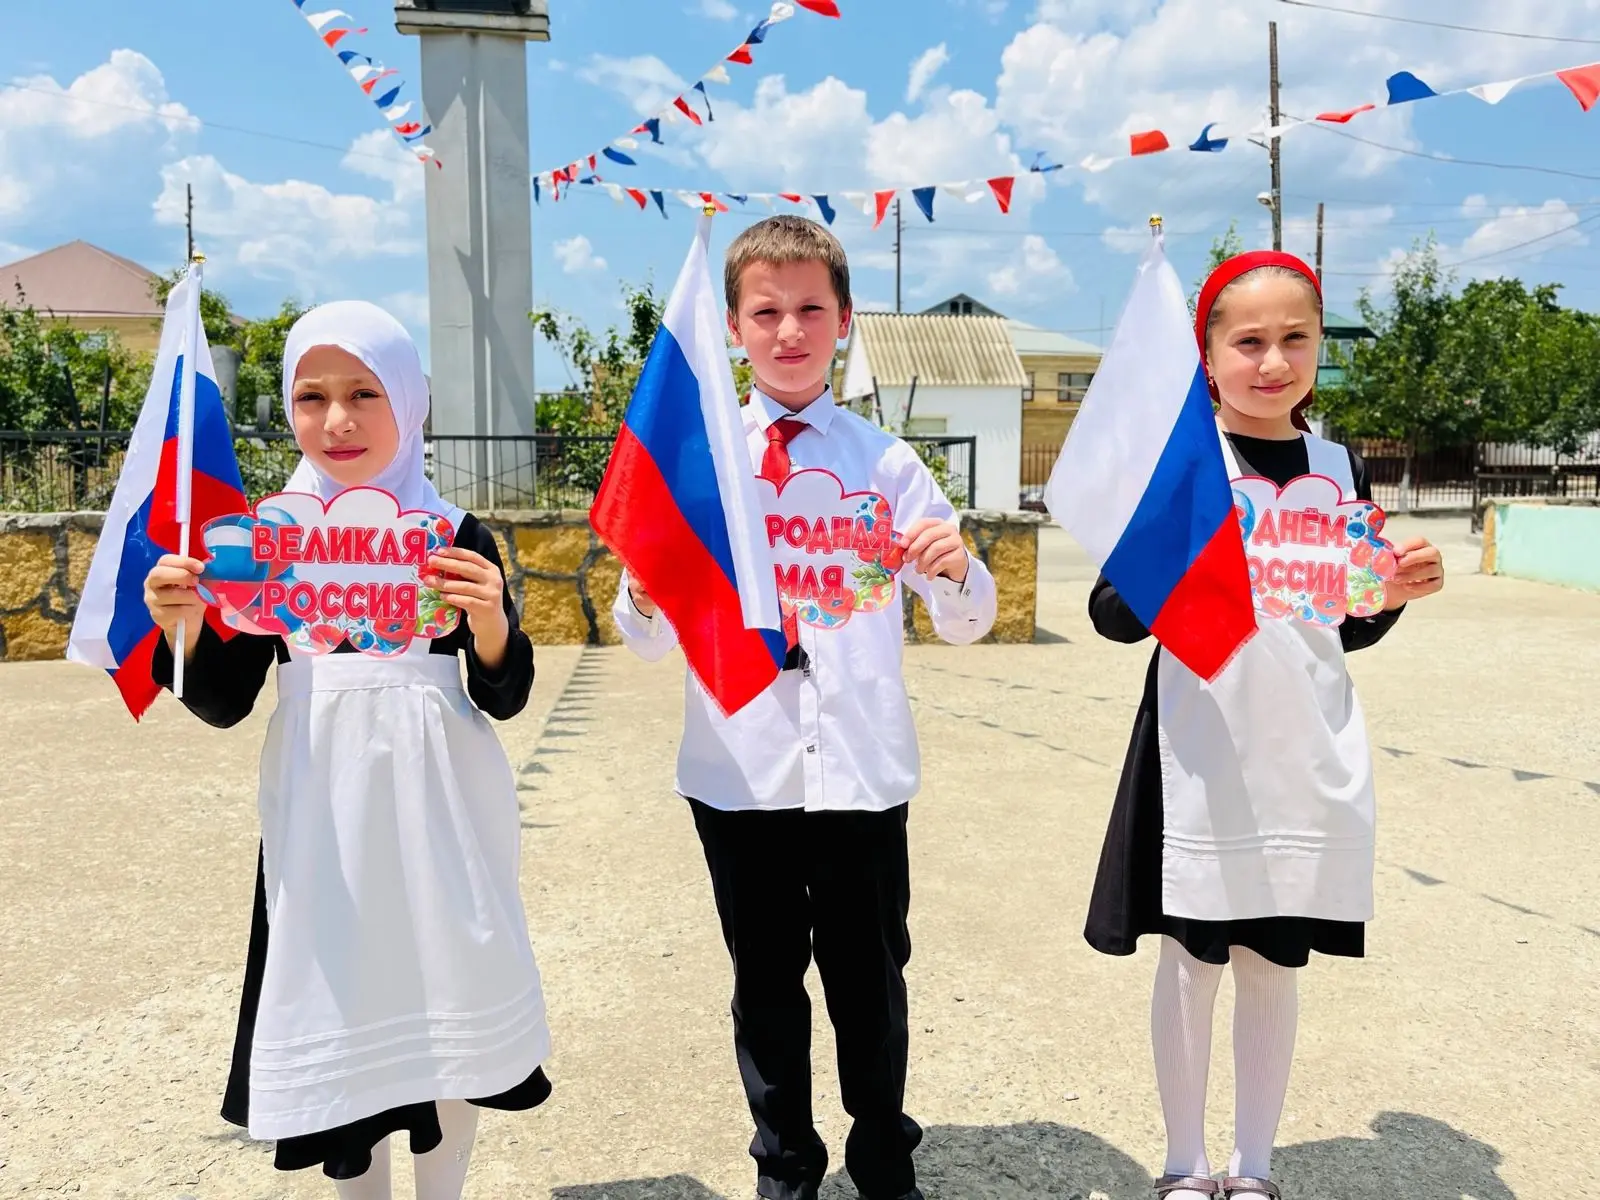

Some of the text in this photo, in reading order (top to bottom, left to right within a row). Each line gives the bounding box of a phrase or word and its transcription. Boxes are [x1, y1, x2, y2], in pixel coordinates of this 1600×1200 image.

[251, 525, 428, 565] ВЕЛИКАЯ
[765, 514, 893, 555] РОДНАЯ
[1252, 507, 1348, 549] ДНЁМ
[774, 564, 845, 600] МЛЯ
[1246, 555, 1348, 597] ОССИИ
[262, 580, 418, 620] РОССИЯ
